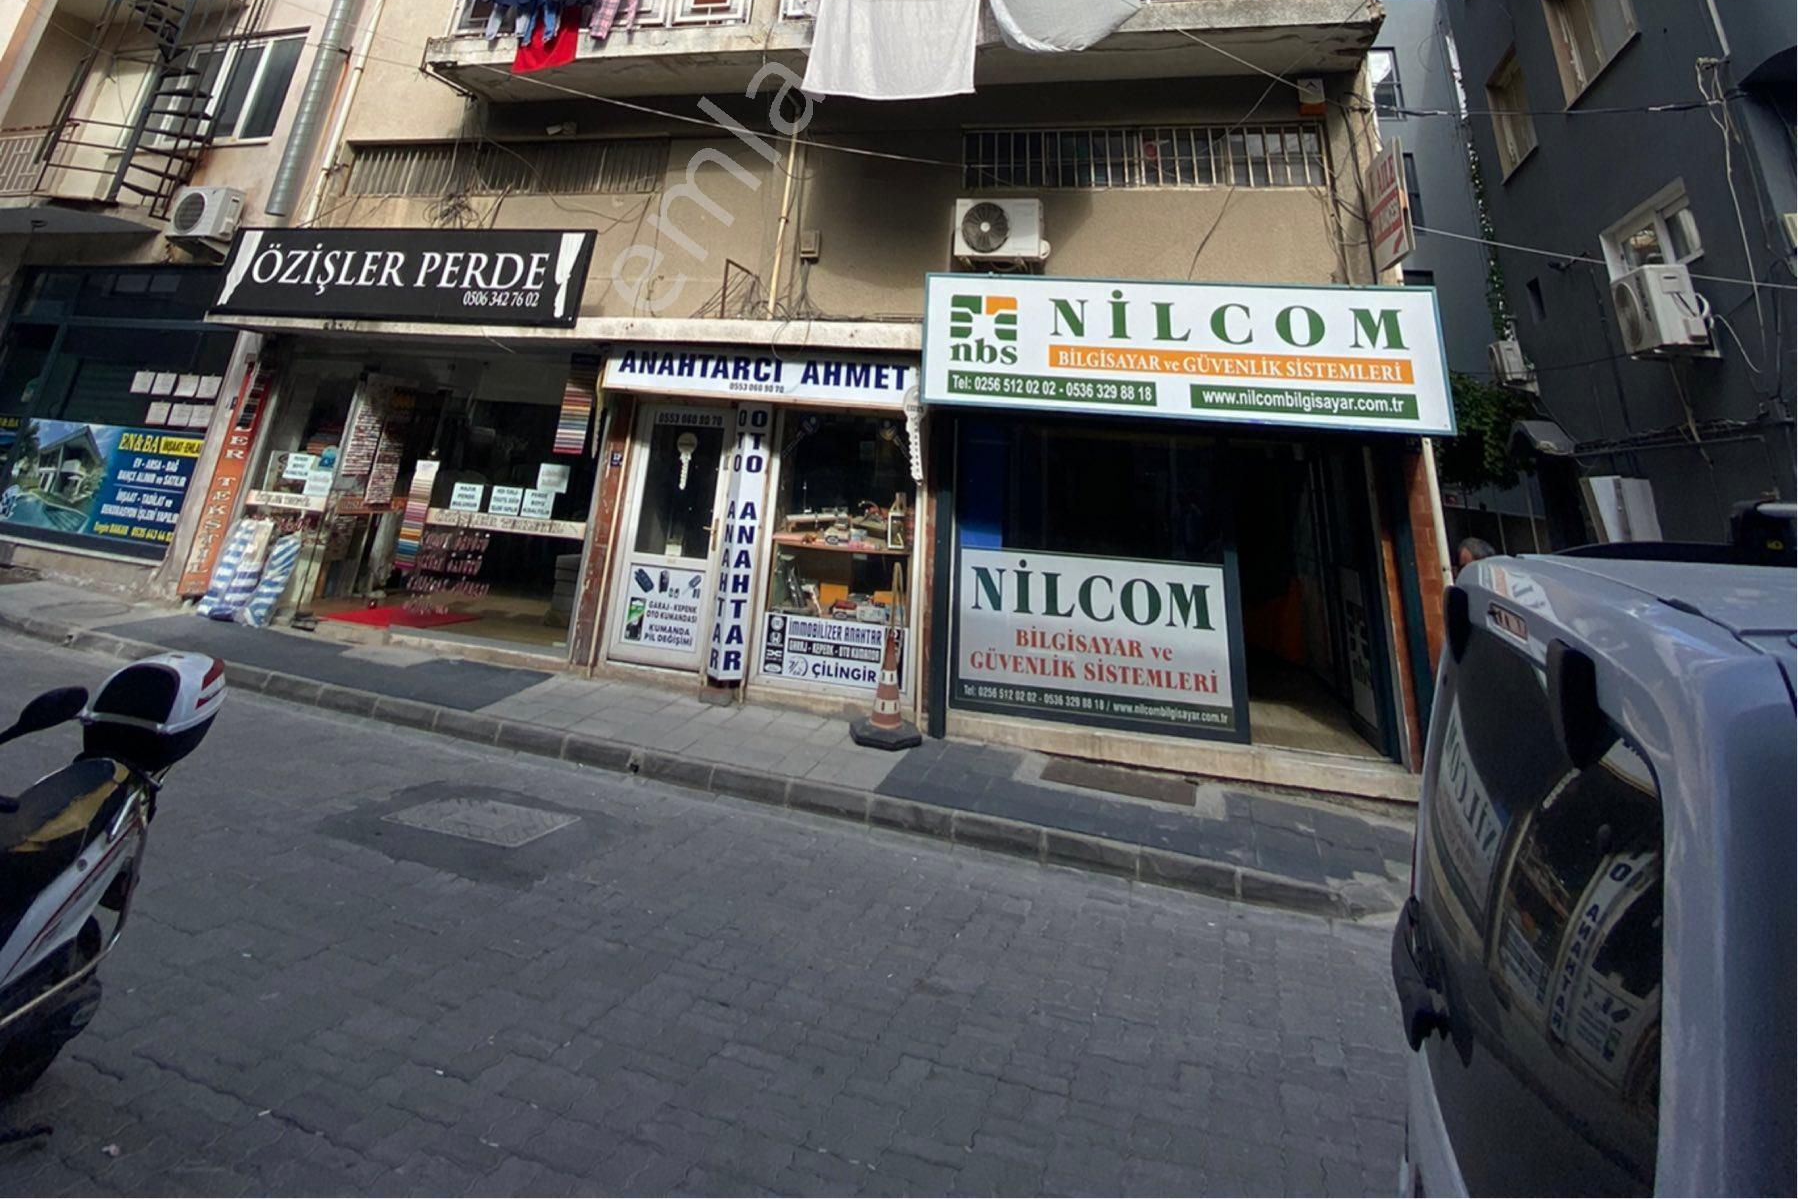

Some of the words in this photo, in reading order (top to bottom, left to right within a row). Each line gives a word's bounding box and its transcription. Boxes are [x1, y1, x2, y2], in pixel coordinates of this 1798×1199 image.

[252, 243, 405, 295] ÖZİŞLER
[413, 252, 549, 290] PERDE
[463, 290, 488, 307] 0506
[488, 291, 511, 307] 342
[511, 292, 525, 307] 76
[525, 292, 540, 307] 02
[1049, 290, 1410, 350] NİLCOM
[950, 338, 1018, 365] nbs
[1058, 348, 1160, 371] BİLGİSAYAR
[1164, 359, 1180, 372] ve
[1183, 354, 1284, 377] GÜVENLİK
[1286, 358, 1403, 382] SİSTEMLERİ
[618, 350, 783, 383] ANAHTARCI
[800, 360, 910, 391] AHMET
[729, 382, 748, 392] 0553
[952, 375, 972, 390] Tel:
[974, 376, 1000, 392] 0256
[1003, 378, 1023, 394] 512
[1025, 380, 1040, 395] 02
[1041, 381, 1057, 396] 02
[1066, 382, 1094, 398] 0536
[1096, 384, 1118, 400] 329
[1120, 385, 1136, 401] 88
[1138, 386, 1153, 402] 18
[1202, 388, 1405, 415] www.nilcombilgisayar.com.tr
[659, 412, 680, 425] 0553
[733, 410, 748, 473] OTO
[745, 410, 768, 473] OTO
[709, 501, 735, 671] ANAHTAR
[722, 502, 758, 671] ANAHTAR
[971, 559, 1216, 631] NİLCOM
[646, 610, 659, 619] OTO
[660, 612, 698, 623] KUMANDASI
[648, 600, 670, 611] GARAJ
[648, 624, 691, 636] KUMANDA
[1015, 625, 1144, 659] BİLGİSAYAR
[1151, 646, 1173, 662] ve
[812, 660, 877, 683] ÇİLİNGİR
[970, 648, 1077, 679] GÜVENLİK
[1083, 659, 1219, 694] SİSTEMLERİ
[964, 684, 976, 696] Tel:
[978, 685, 998, 698] 0256
[999, 687, 1014, 700] 512
[1015, 689, 1026, 701] 02
[1026, 690, 1038, 702] 02
[1043, 692, 1064, 706] 0536
[1065, 694, 1081, 707] 329
[1082, 696, 1094, 709] 88
[1094, 698, 1104, 710] 18
[1112, 702, 1229, 725] www.nilcombilgisayar.com.tr
